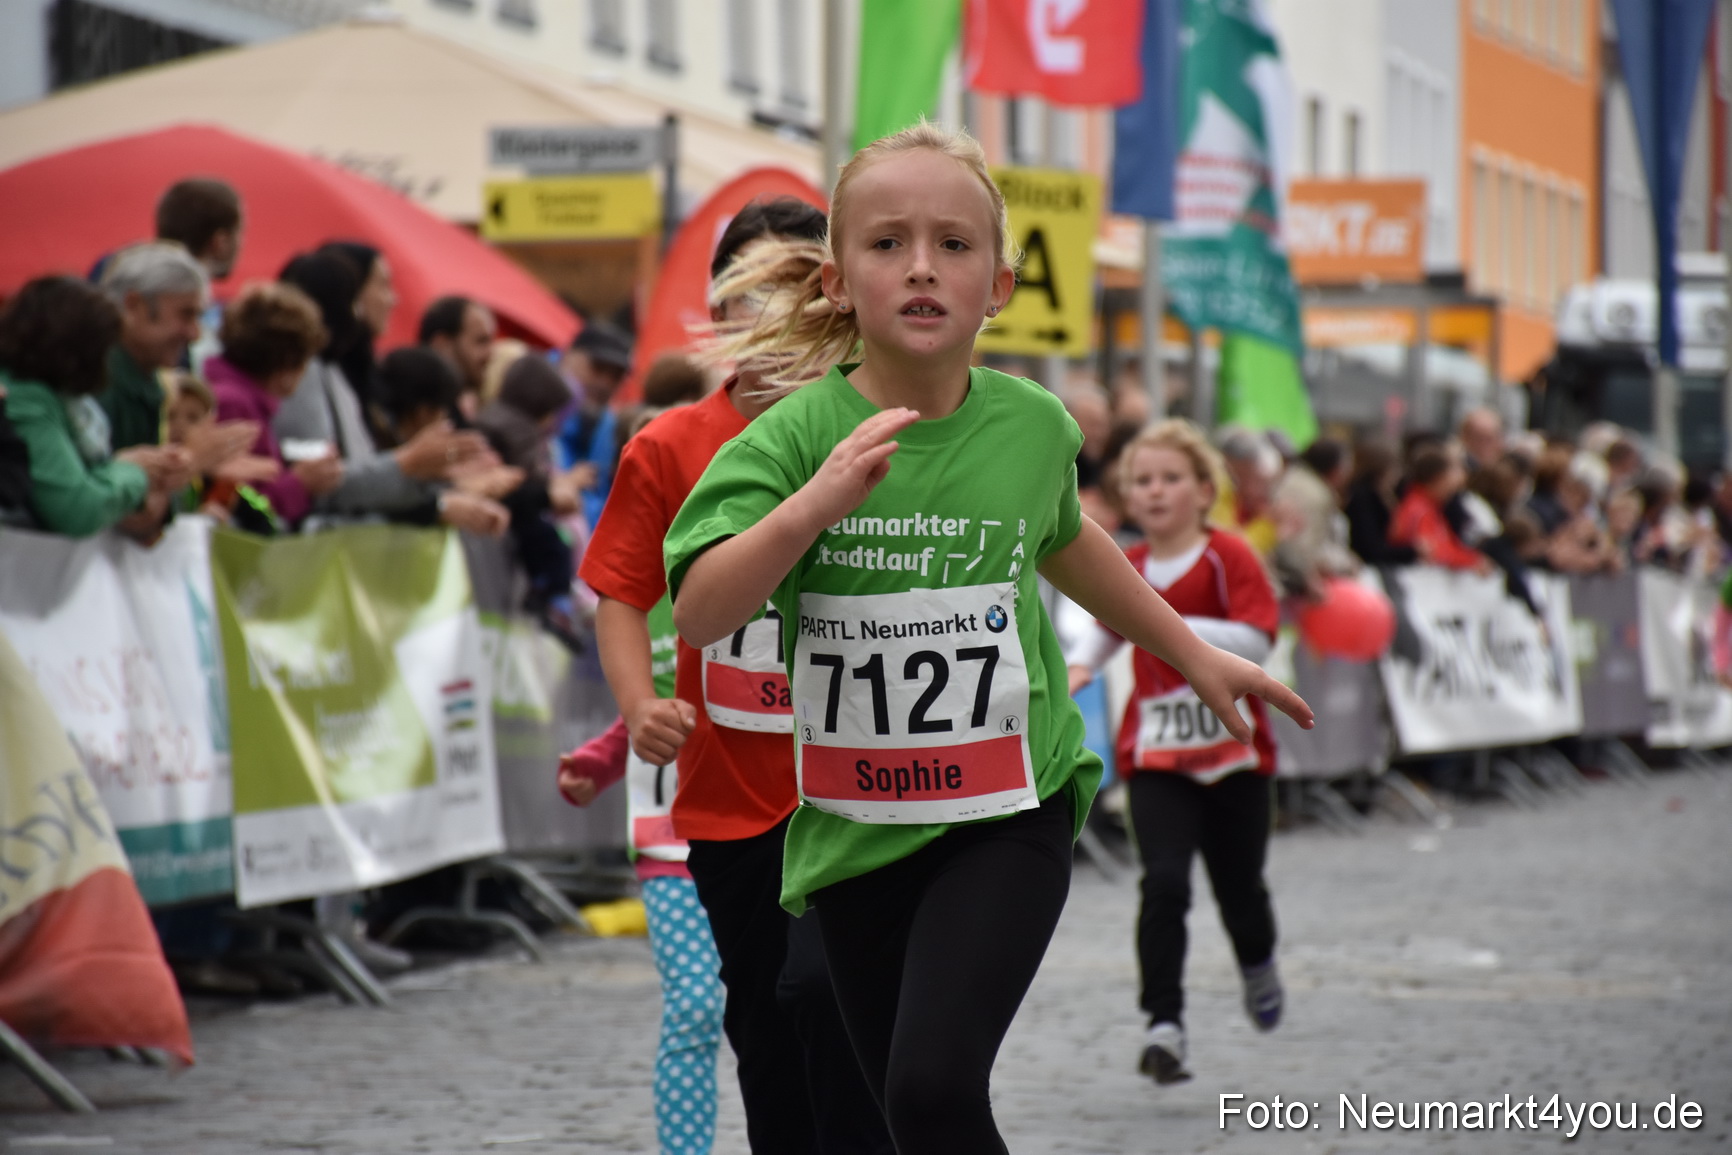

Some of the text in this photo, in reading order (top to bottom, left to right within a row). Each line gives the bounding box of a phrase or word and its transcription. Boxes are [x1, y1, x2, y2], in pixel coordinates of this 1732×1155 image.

[1010, 229, 1059, 311] A
[826, 512, 970, 537] eumarkter
[801, 613, 978, 640] PARTL Neumarkt
[809, 645, 1000, 735] 7127
[855, 759, 963, 799] Sophie
